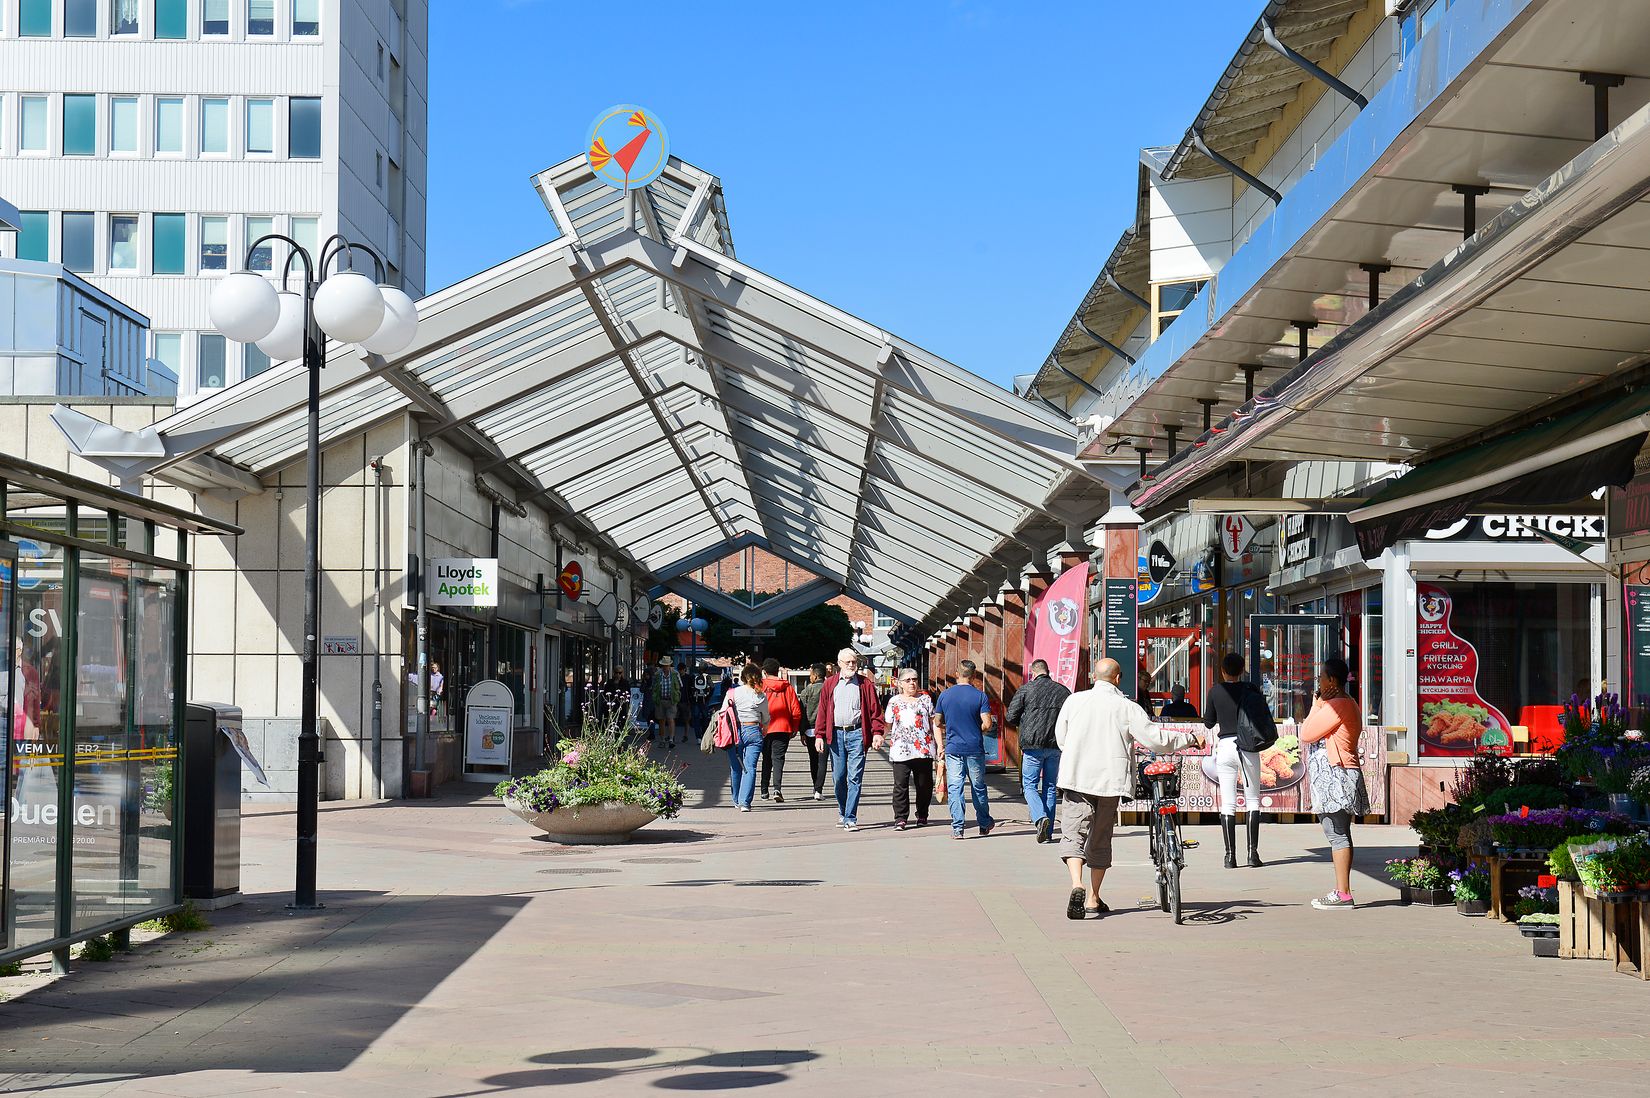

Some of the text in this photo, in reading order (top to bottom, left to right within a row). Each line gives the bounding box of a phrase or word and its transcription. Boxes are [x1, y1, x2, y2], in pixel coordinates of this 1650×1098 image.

[1482, 515, 1606, 538] CHICK
[437, 565, 483, 582] Lloyds
[437, 582, 490, 599] Apotek
[1431, 641, 1459, 650] GRILL
[1423, 654, 1468, 663] FRITERAD
[1419, 675, 1473, 684] SHAWARMA
[16, 743, 43, 754] VEM
[1189, 796, 1213, 807] 989
[13, 836, 46, 844] PREMIÄR
